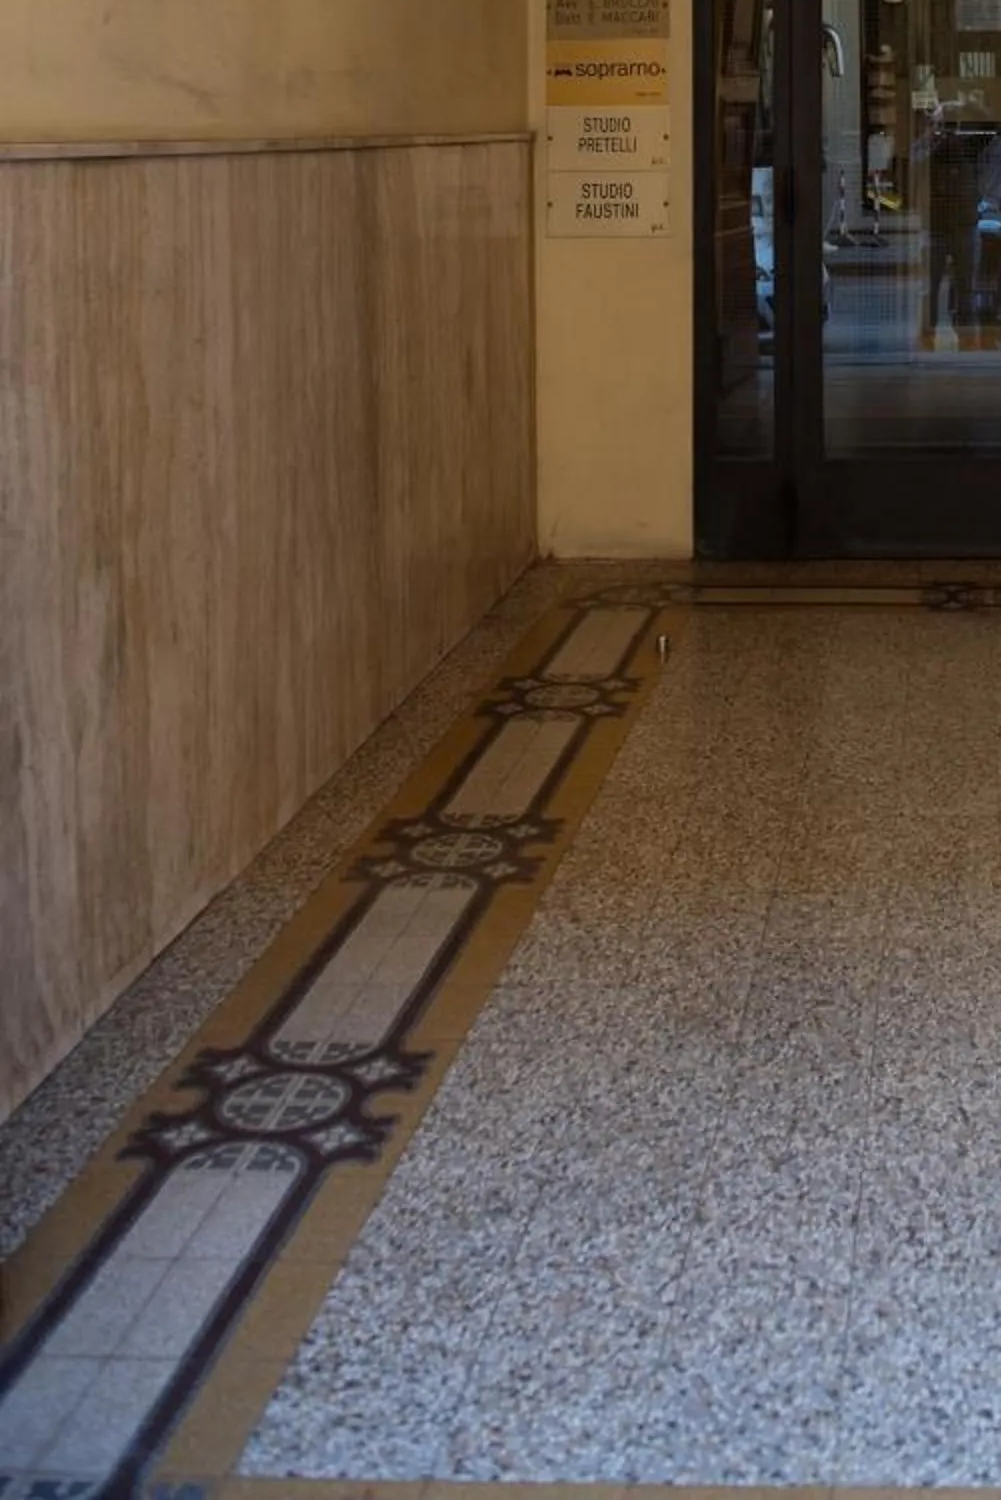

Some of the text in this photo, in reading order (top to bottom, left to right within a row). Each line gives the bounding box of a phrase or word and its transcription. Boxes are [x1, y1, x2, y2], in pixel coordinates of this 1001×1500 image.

[575, 61, 661, 81] soprarno
[583, 116, 631, 133] STUDIO
[577, 136, 638, 153] PRETELLI
[581, 182, 634, 199] STUDIO
[575, 203, 639, 219] FAUSTINI
